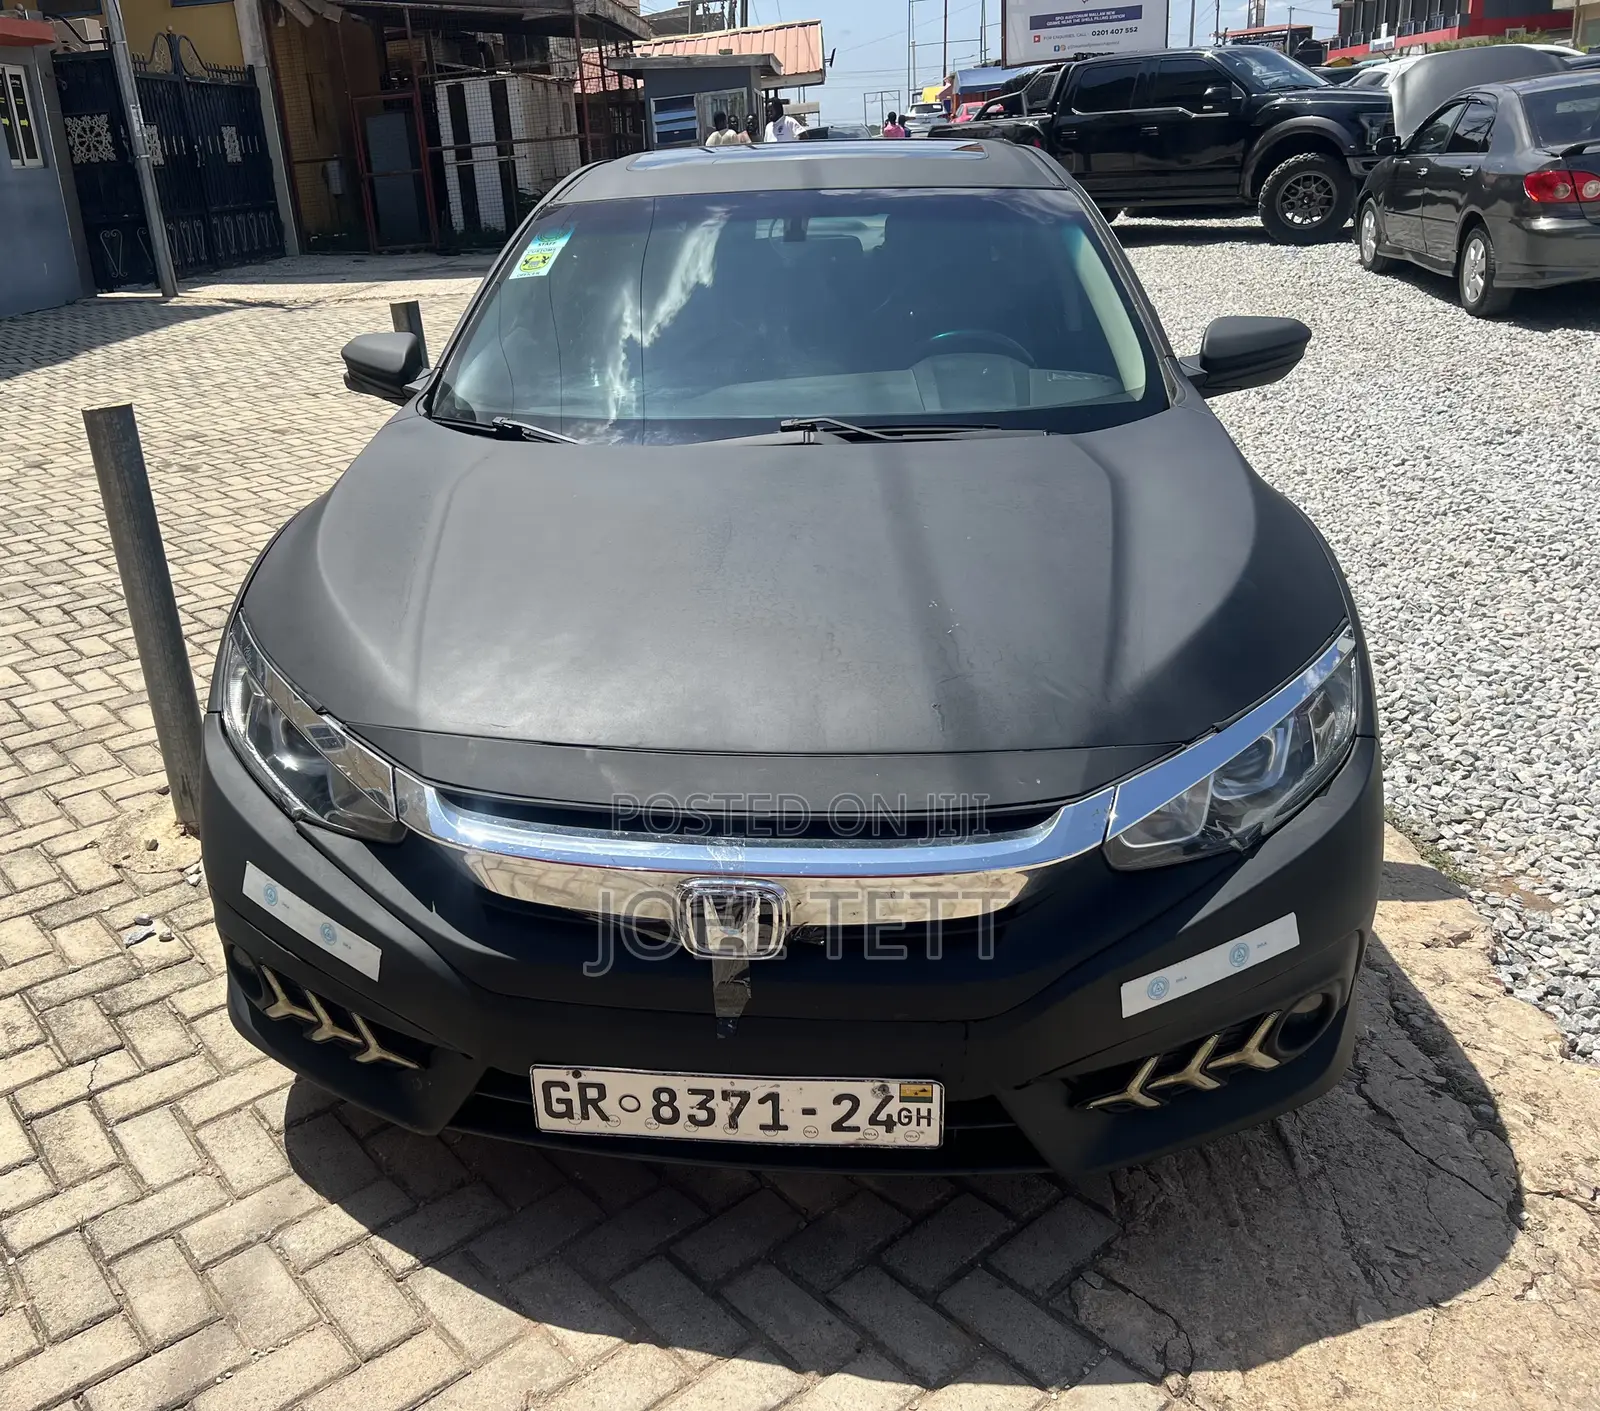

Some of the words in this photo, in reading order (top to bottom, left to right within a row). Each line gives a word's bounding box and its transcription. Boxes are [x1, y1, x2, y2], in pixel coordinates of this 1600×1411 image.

[1125, 26, 1138, 34] 552
[541, 1080, 610, 1122] GR
[651, 1086, 789, 1132] 8371
[830, 1093, 898, 1134] 24
[897, 1106, 932, 1128] GH
